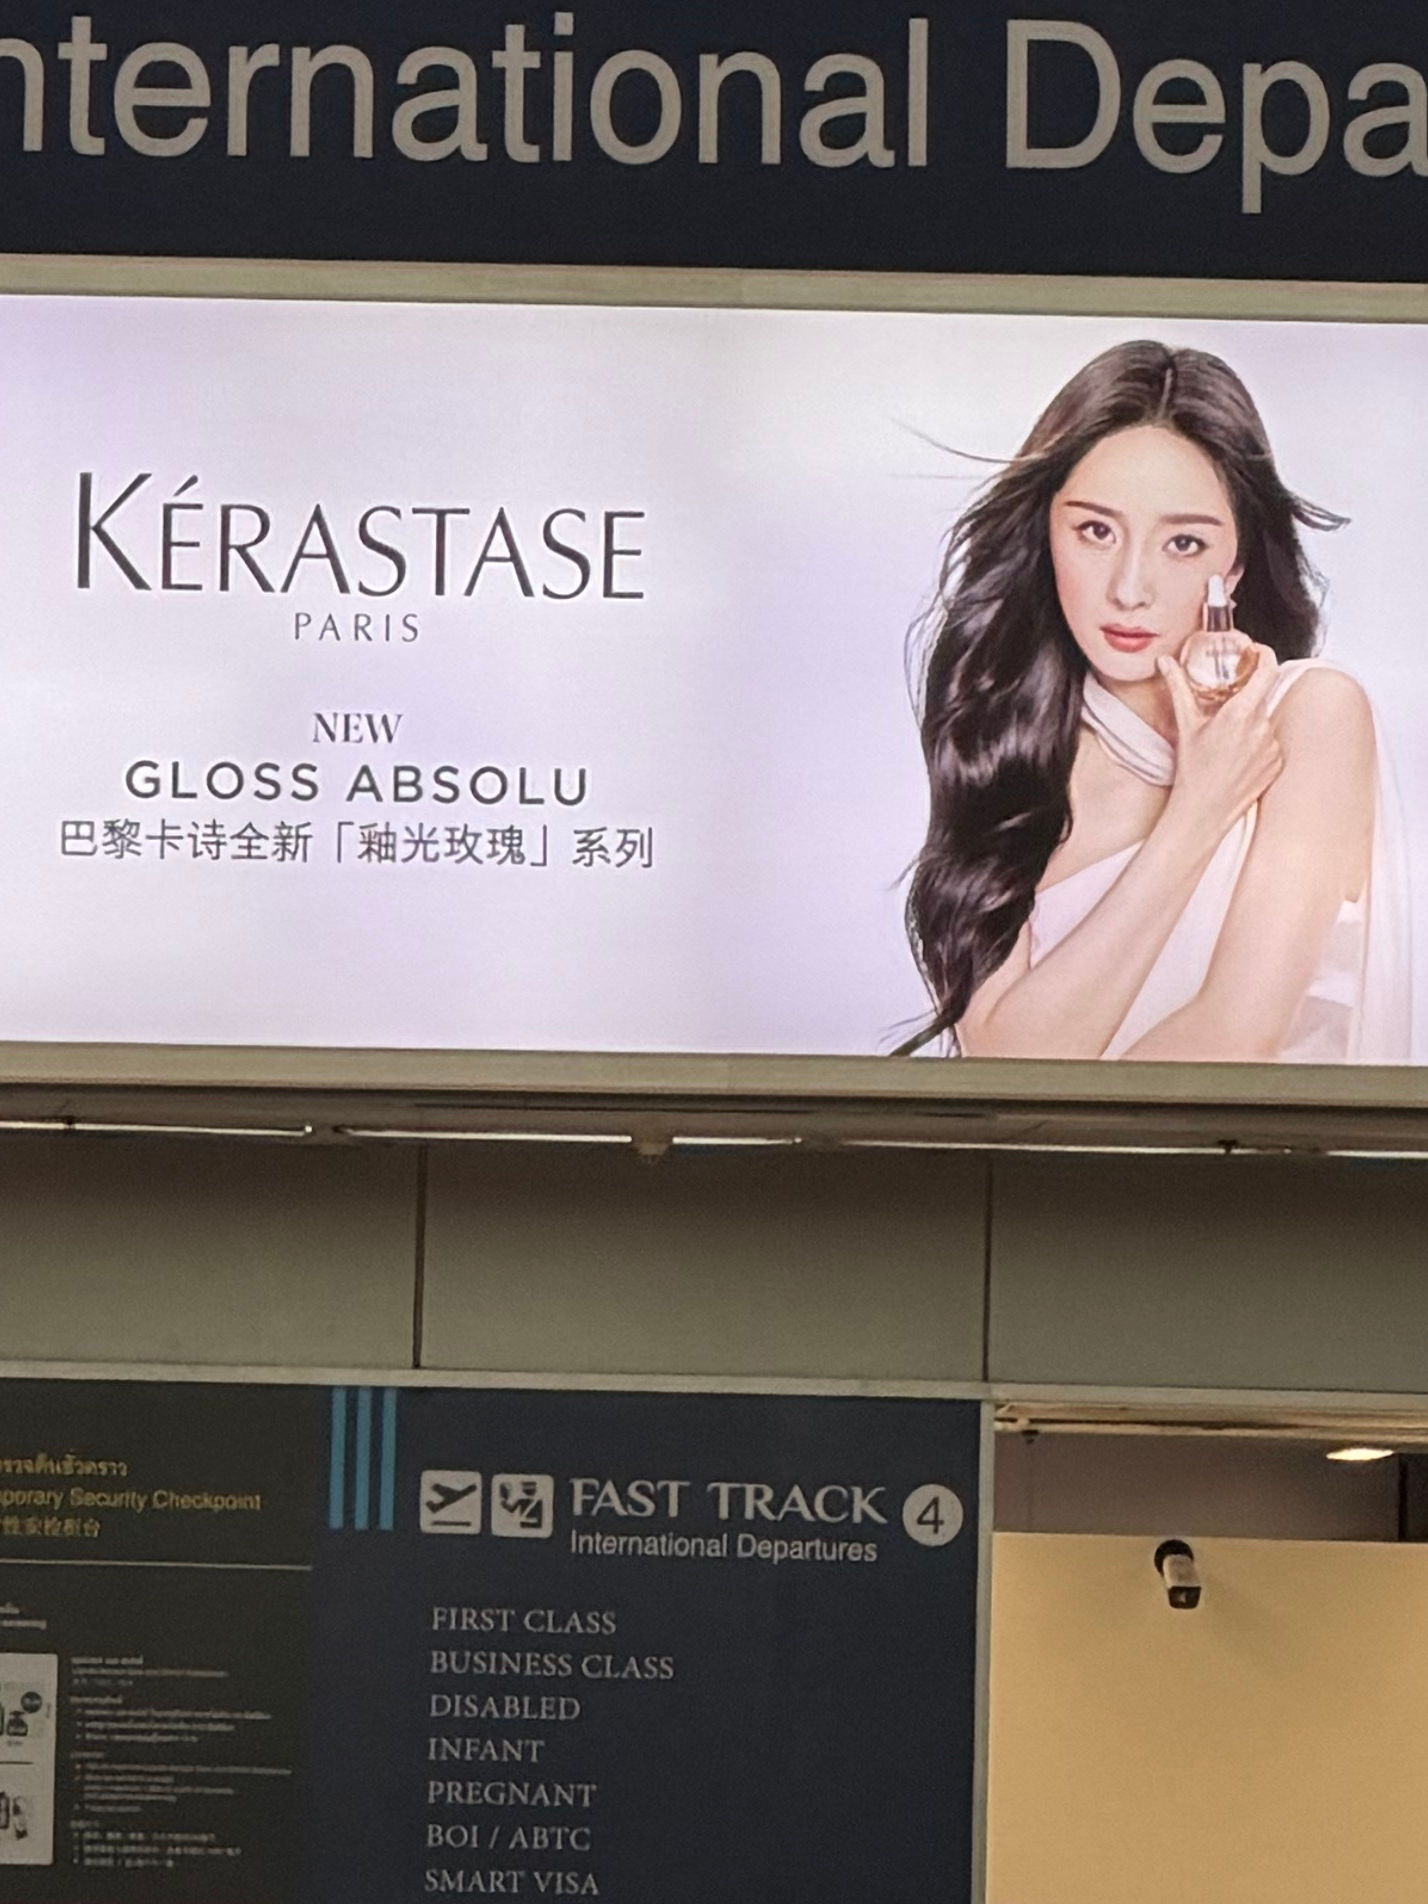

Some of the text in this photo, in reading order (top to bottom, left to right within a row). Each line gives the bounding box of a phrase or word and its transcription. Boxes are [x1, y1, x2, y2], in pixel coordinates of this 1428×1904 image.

[77, 472, 645, 600] KÉRASTASE
[294, 612, 419, 643] PARIS
[313, 712, 402, 744] NEW
[125, 760, 586, 807] GLOSS ABSOLU
[69, 1486, 148, 1513] Security
[152, 1489, 261, 1513] Checkpoint
[571, 1478, 888, 1524] FAST TRACK
[916, 1496, 945, 1535] 4
[571, 1529, 878, 1565] International Departures
[432, 1607, 617, 1635] FIRST CLASS
[430, 1650, 674, 1680] BUSINESS CLASS
[430, 1694, 581, 1721] DISABLED
[428, 1737, 545, 1763] INFANT
[428, 1780, 597, 1808] PREGNANT
[427, 1824, 591, 1851] BOI / ABTC
[424, 1869, 599, 1896] SMART VISA
